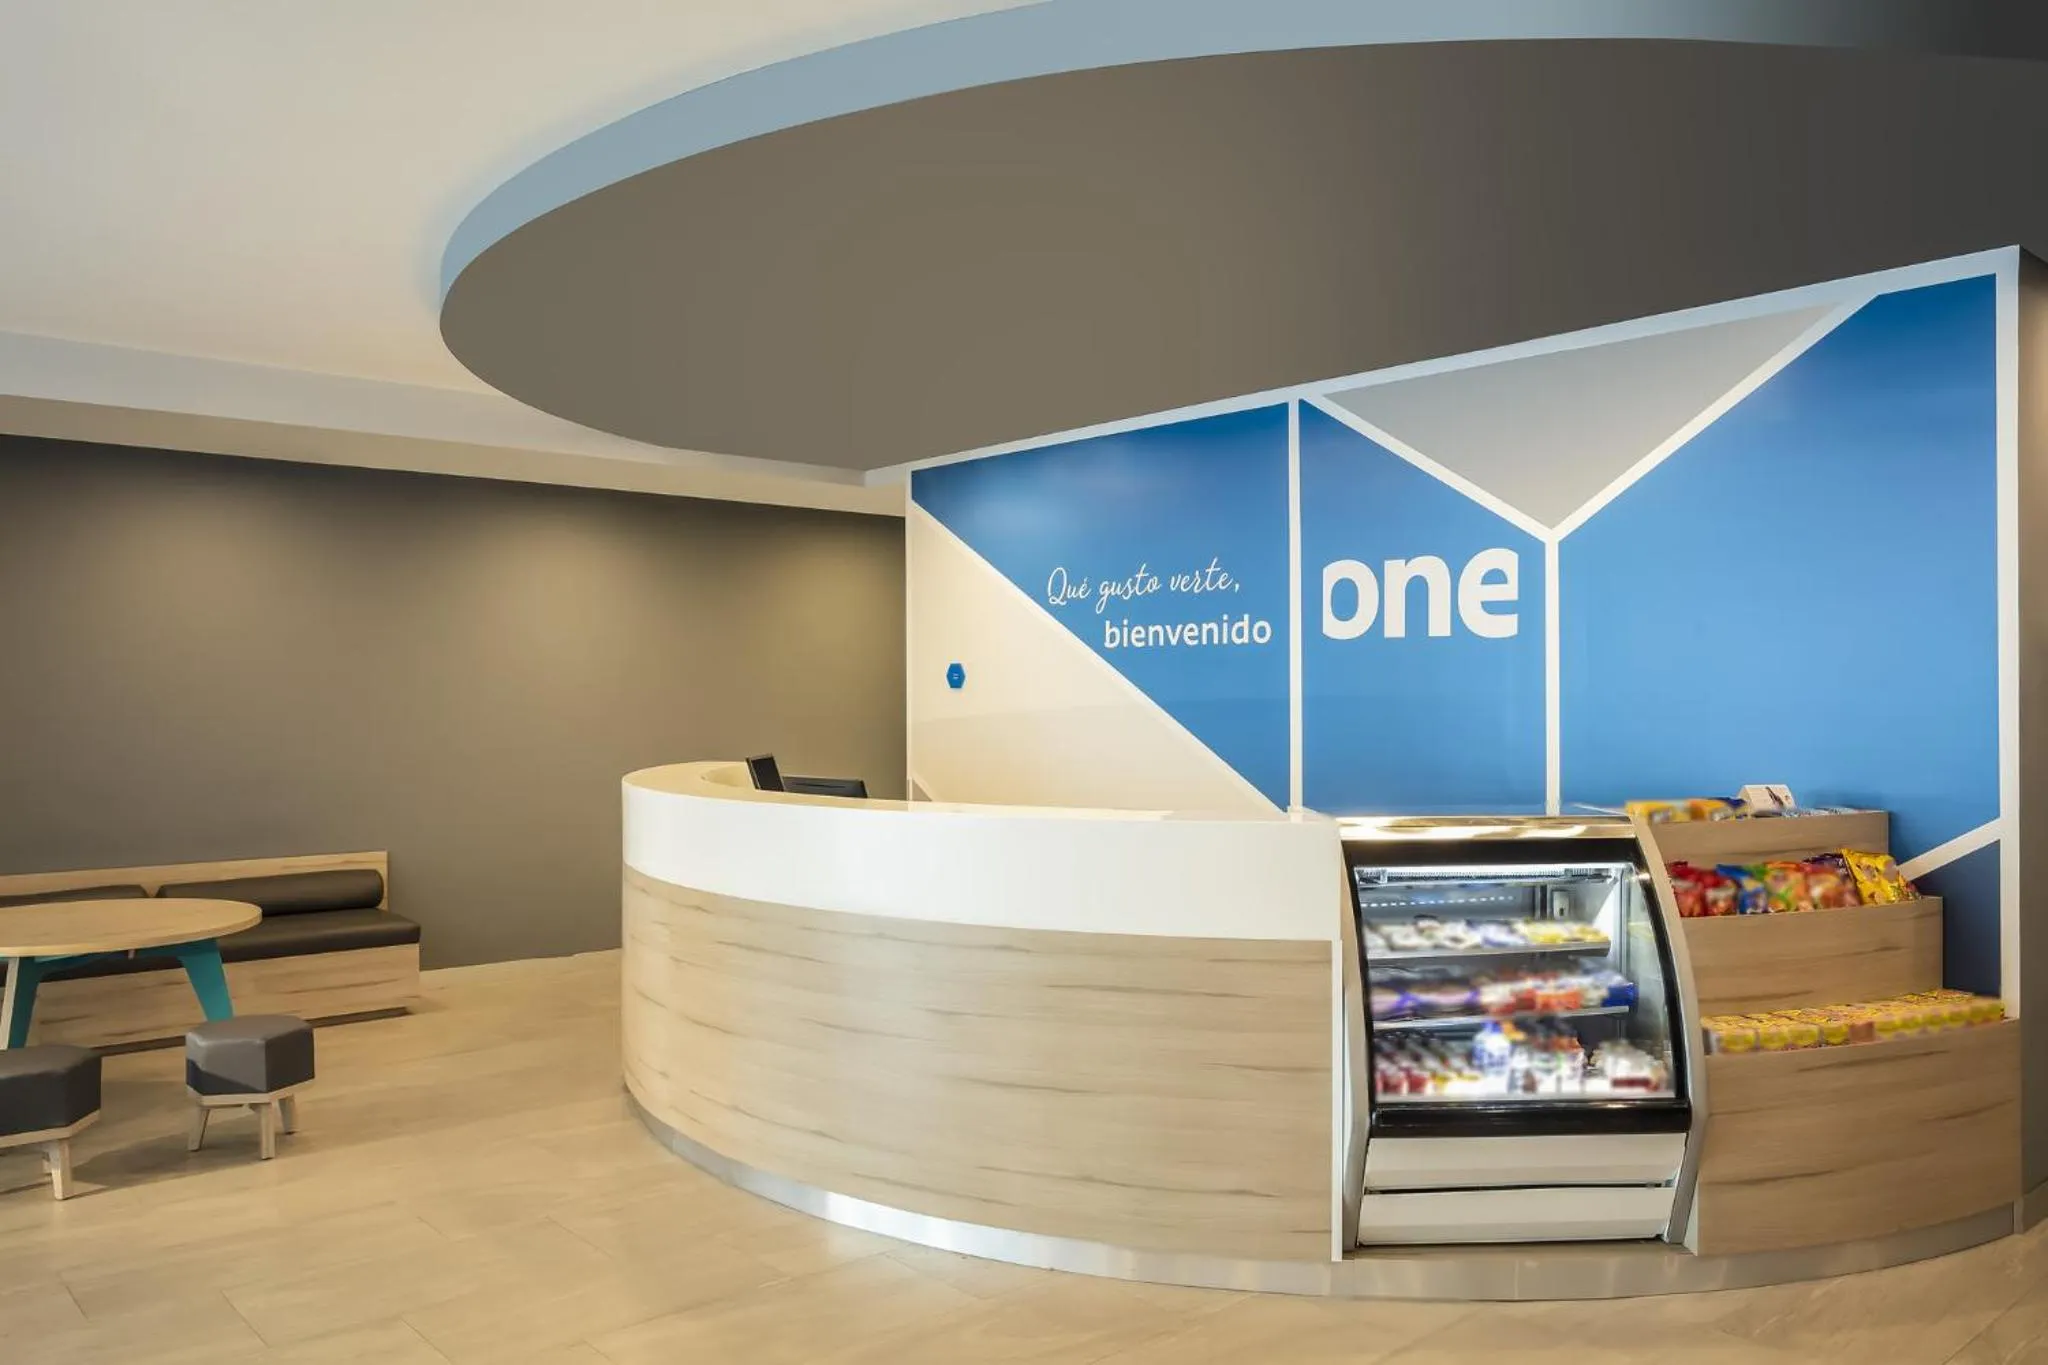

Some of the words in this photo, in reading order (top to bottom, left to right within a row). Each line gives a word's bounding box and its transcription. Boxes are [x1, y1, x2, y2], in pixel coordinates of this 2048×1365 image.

[1047, 567, 1091, 606] Qué
[1095, 563, 1161, 614] gusto
[1169, 557, 1240, 594] verte,
[1322, 547, 1520, 641] one
[1103, 613, 1273, 649] bienvenido
